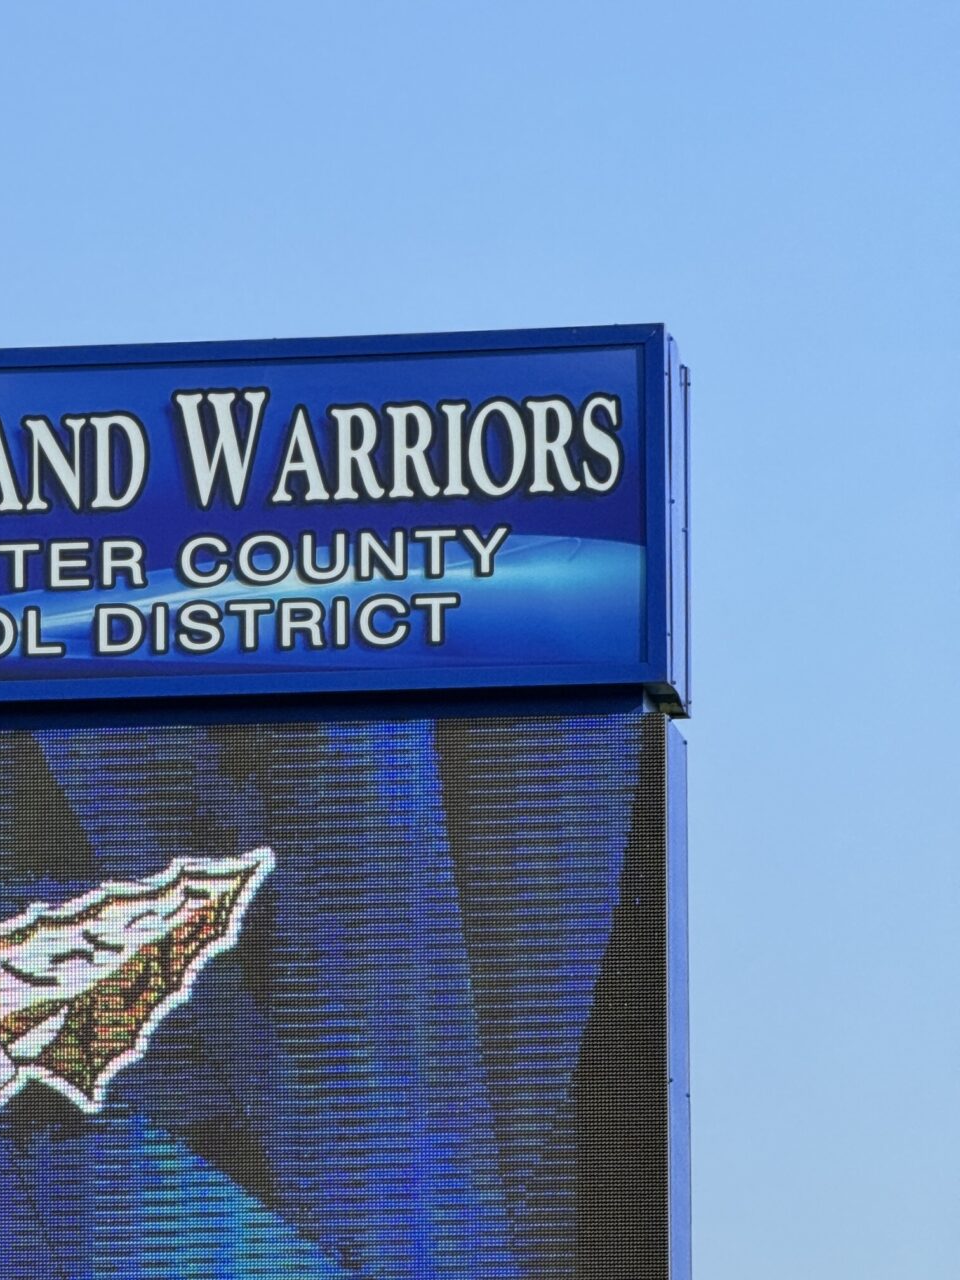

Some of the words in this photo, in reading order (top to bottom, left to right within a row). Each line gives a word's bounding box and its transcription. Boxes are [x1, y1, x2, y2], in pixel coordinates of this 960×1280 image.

[174, 388, 622, 507] WARRIORS
[180, 527, 508, 585] COUNTY
[98, 596, 458, 653] DISTRICT
